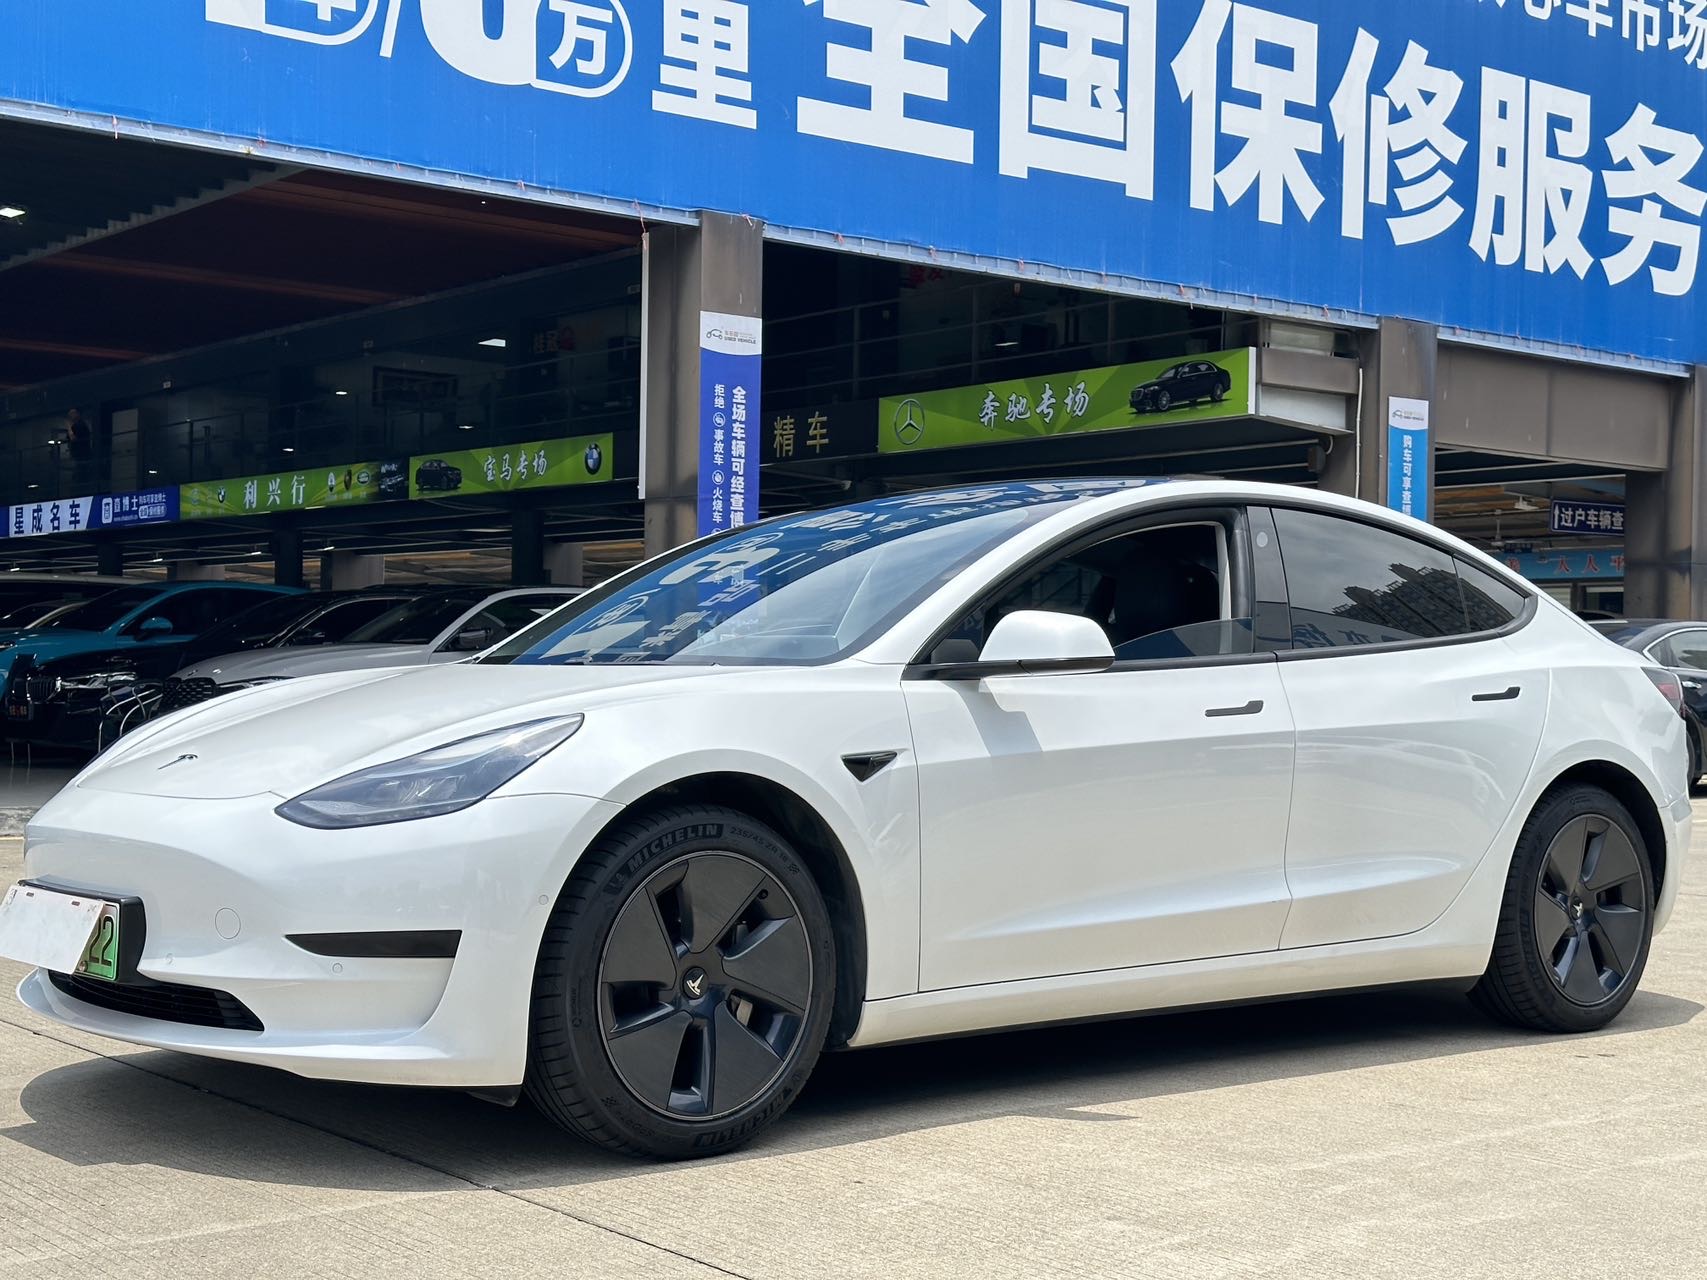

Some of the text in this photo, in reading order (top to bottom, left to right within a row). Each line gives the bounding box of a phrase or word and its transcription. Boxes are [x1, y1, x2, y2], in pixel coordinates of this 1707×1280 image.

[979, 382, 1089, 429] 奔驰专场
[484, 450, 548, 481] 宝马专场
[243, 475, 306, 509] 利兴行
[14, 500, 81, 535] 星成名车
[1560, 508, 1624, 531] 过户车辆查
[627, 824, 717, 873] MICHELIN
